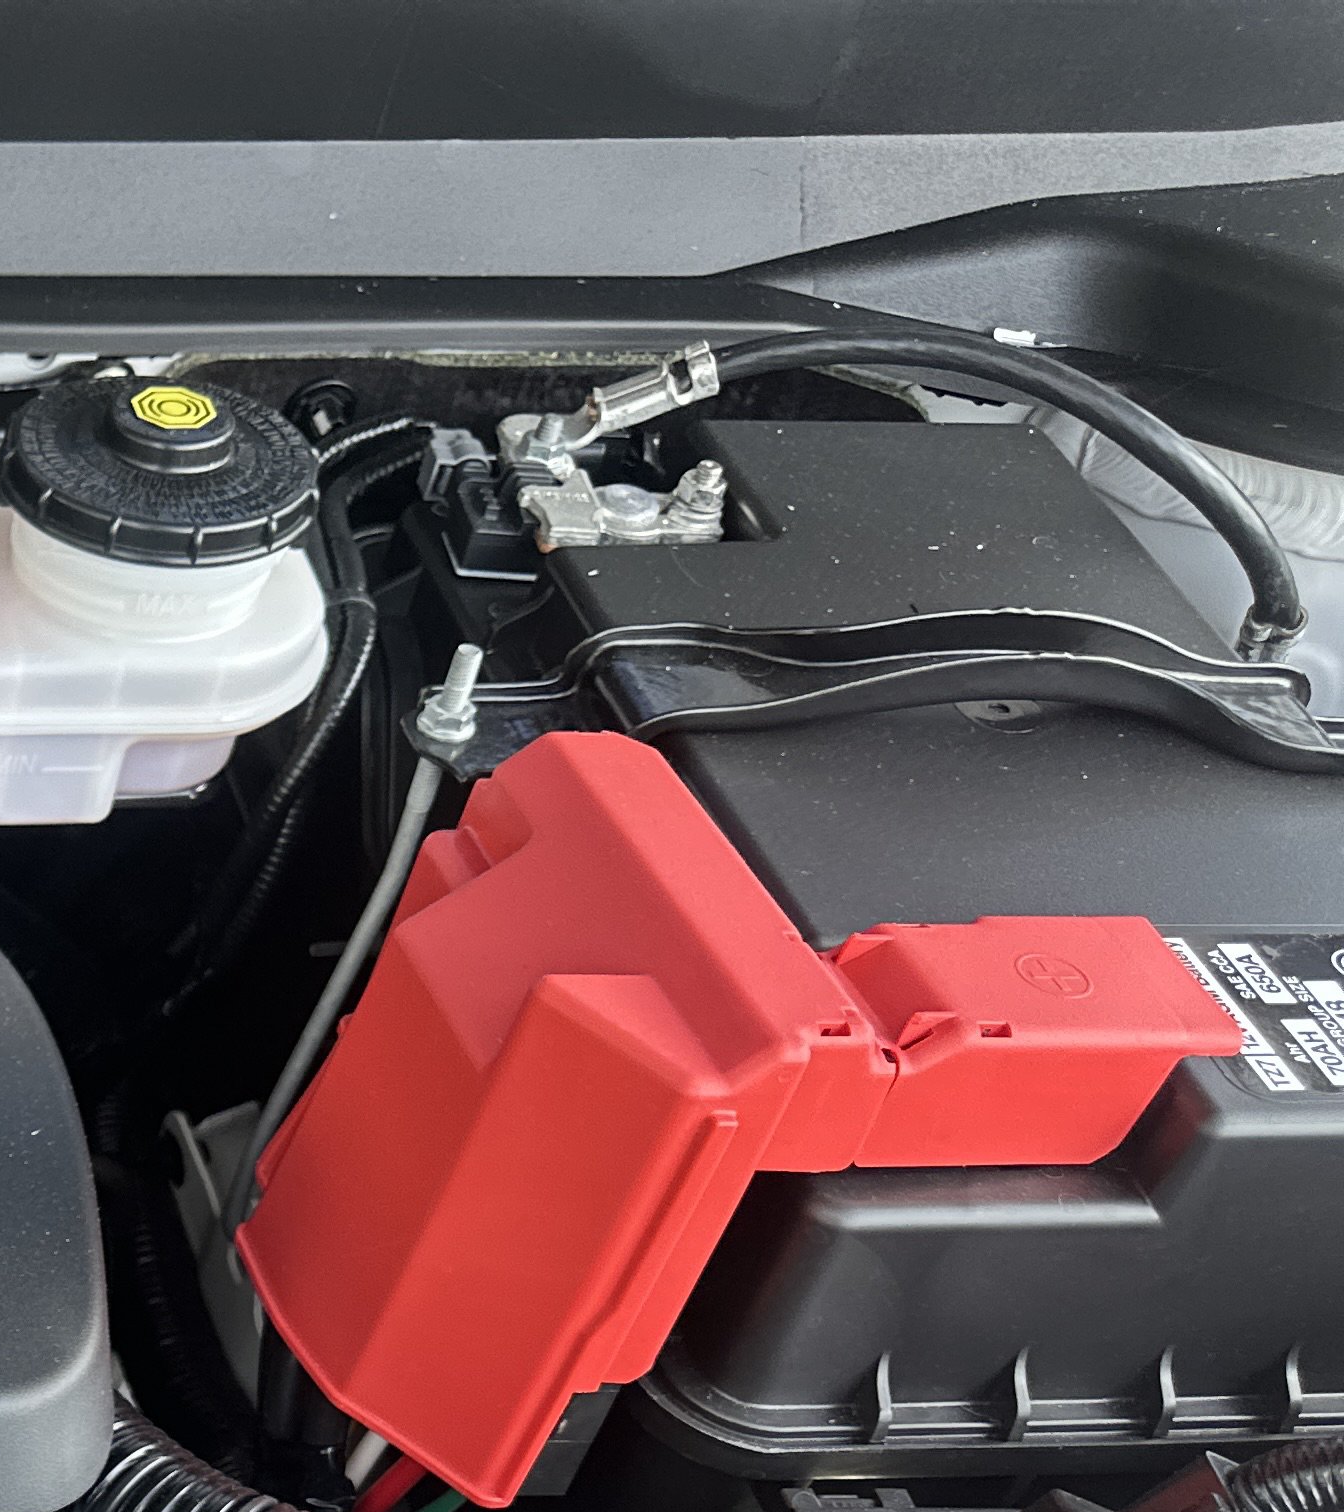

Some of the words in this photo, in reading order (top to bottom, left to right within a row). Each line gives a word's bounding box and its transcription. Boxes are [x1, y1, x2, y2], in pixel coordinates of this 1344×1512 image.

[135, 592, 196, 616] MAX
[1207, 950, 1235, 975] CCA
[1235, 954, 1282, 993] 650A
[1225, 976, 1257, 999] SAE
[1282, 976, 1314, 1002] SIZE
[1285, 1042, 1311, 1063] Ahr
